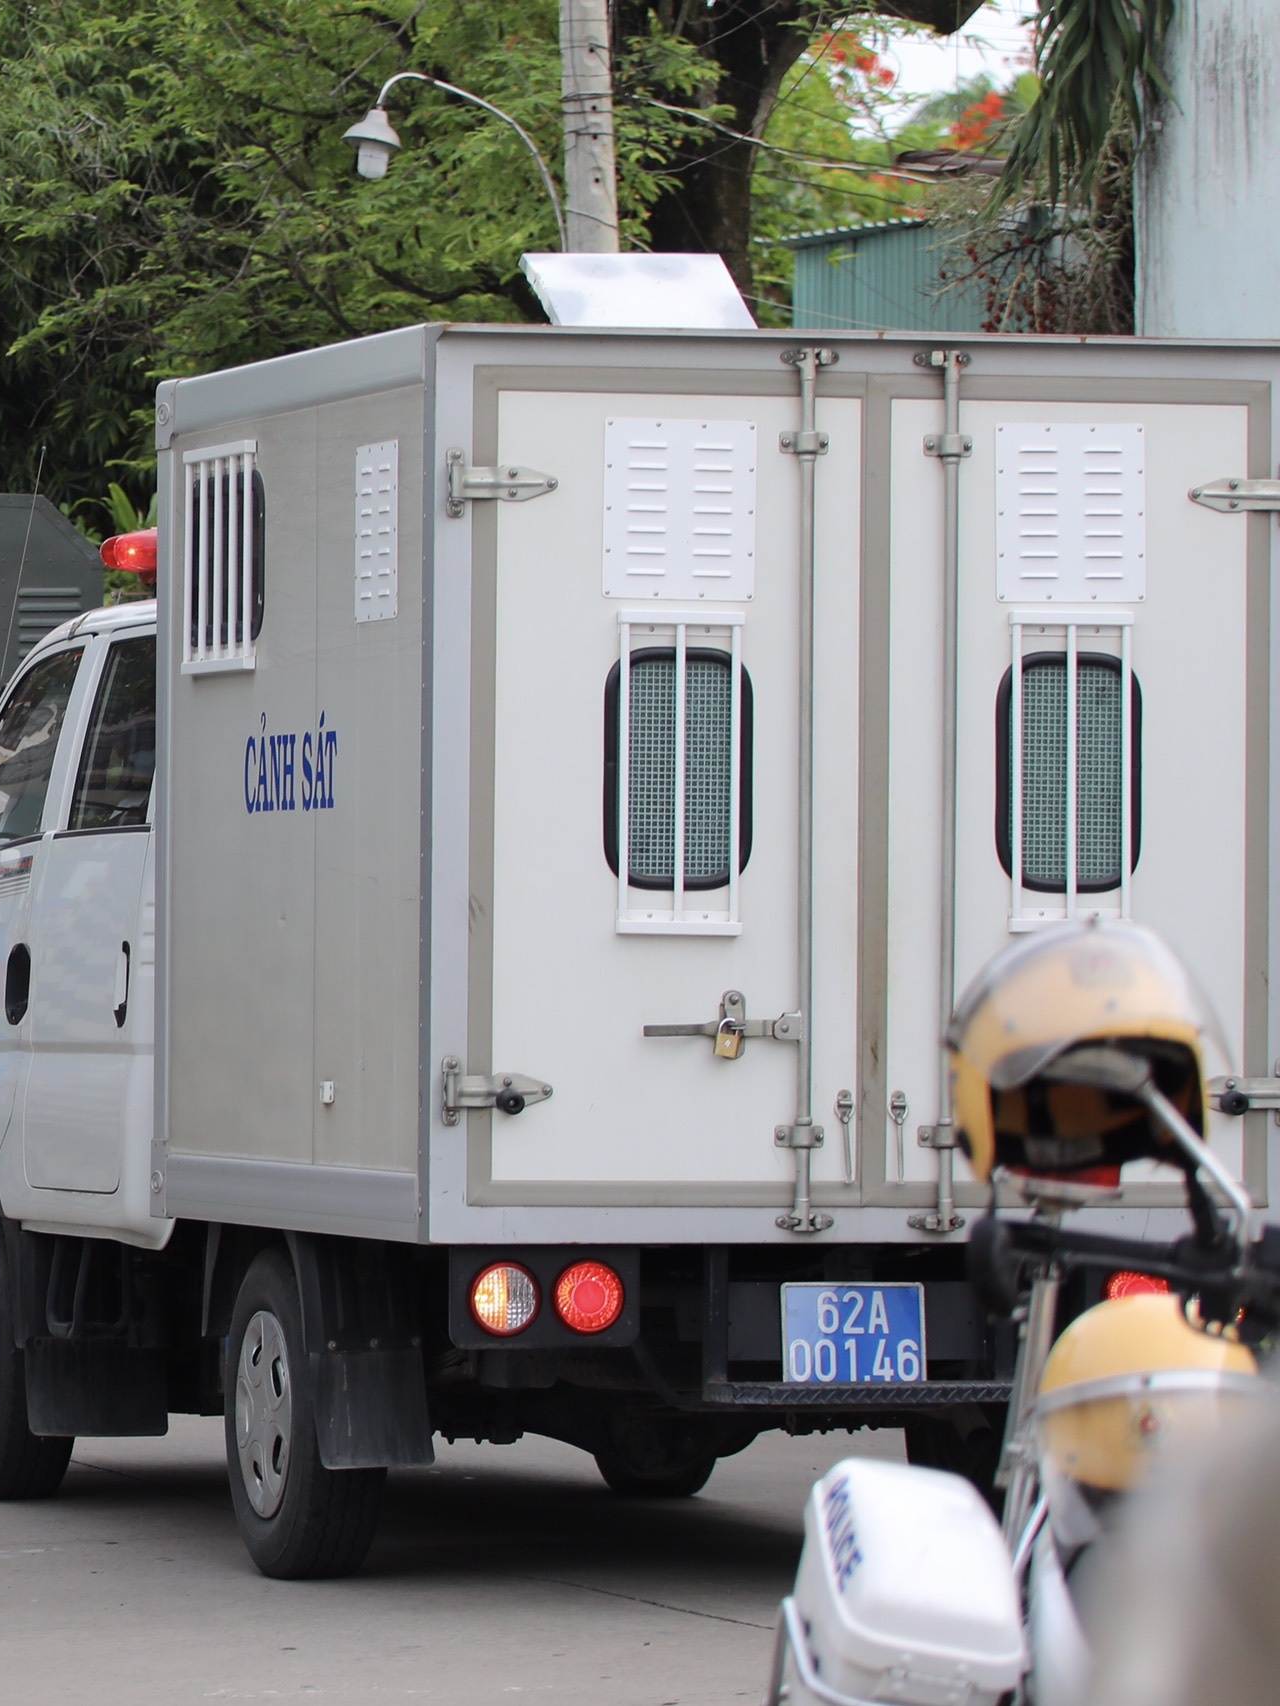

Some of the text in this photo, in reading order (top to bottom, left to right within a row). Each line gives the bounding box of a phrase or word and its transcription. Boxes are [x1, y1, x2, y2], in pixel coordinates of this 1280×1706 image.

[244, 709, 338, 814] CẢNH SÁT
[816, 1290, 890, 1335] 62A
[789, 1338, 920, 1382] 001.46
[822, 1475, 863, 1594] POLICE
